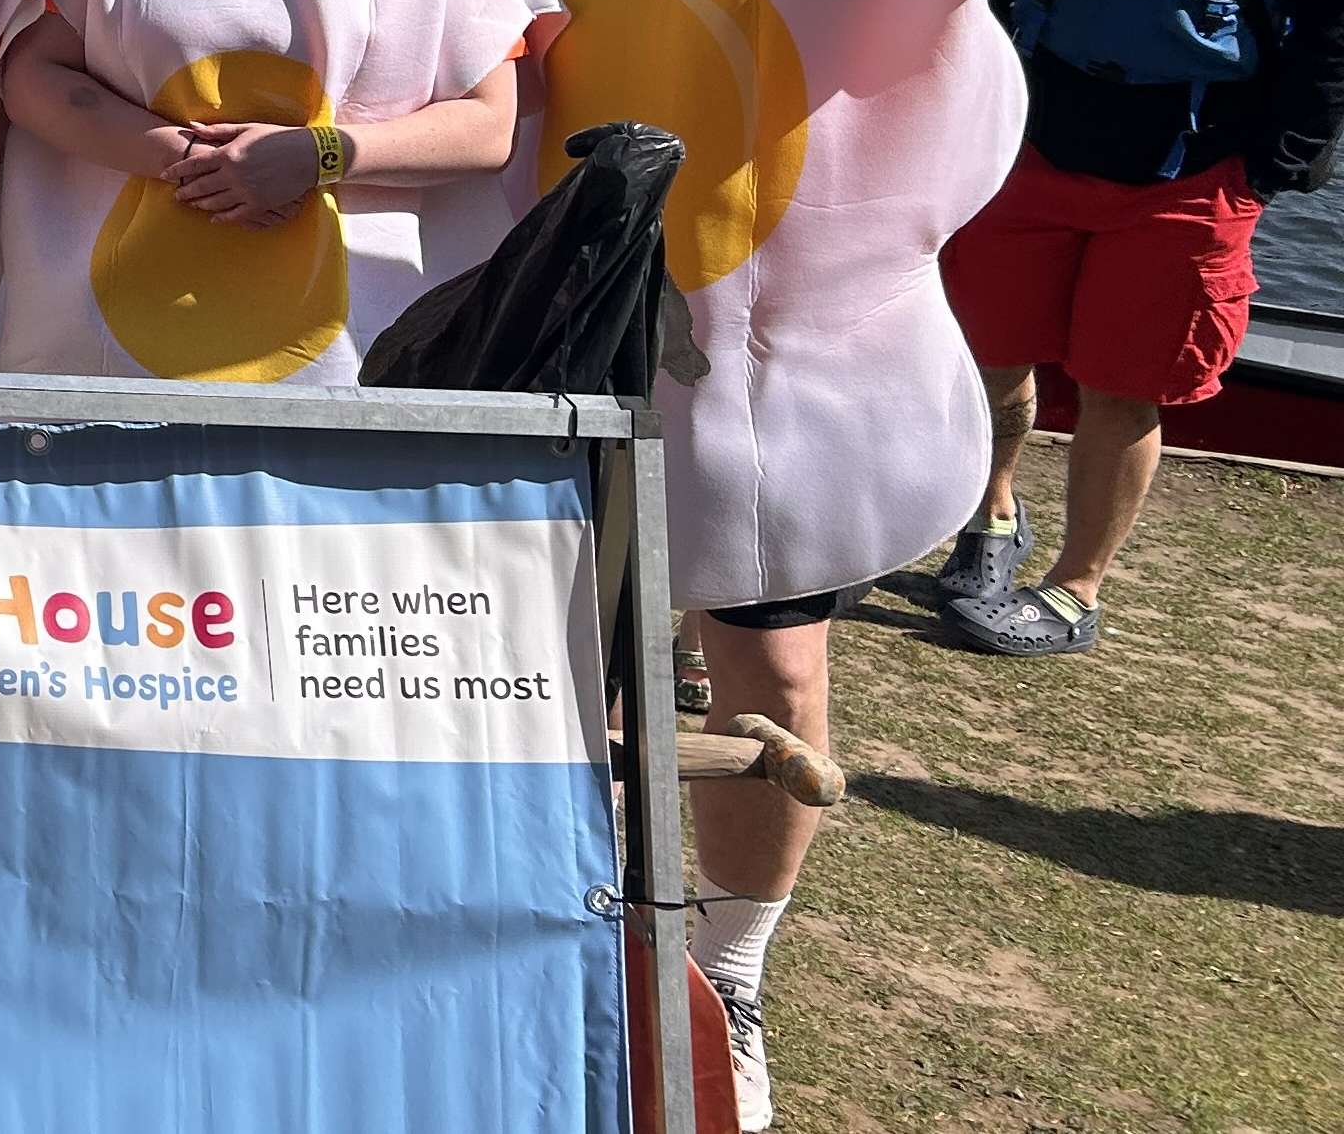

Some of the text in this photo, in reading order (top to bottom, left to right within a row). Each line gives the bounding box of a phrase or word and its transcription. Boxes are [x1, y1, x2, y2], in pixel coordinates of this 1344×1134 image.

[291, 584, 491, 615] Here when
[295, 624, 441, 657] families
[84, 665, 238, 710] Hospice
[300, 668, 551, 700] need us most
